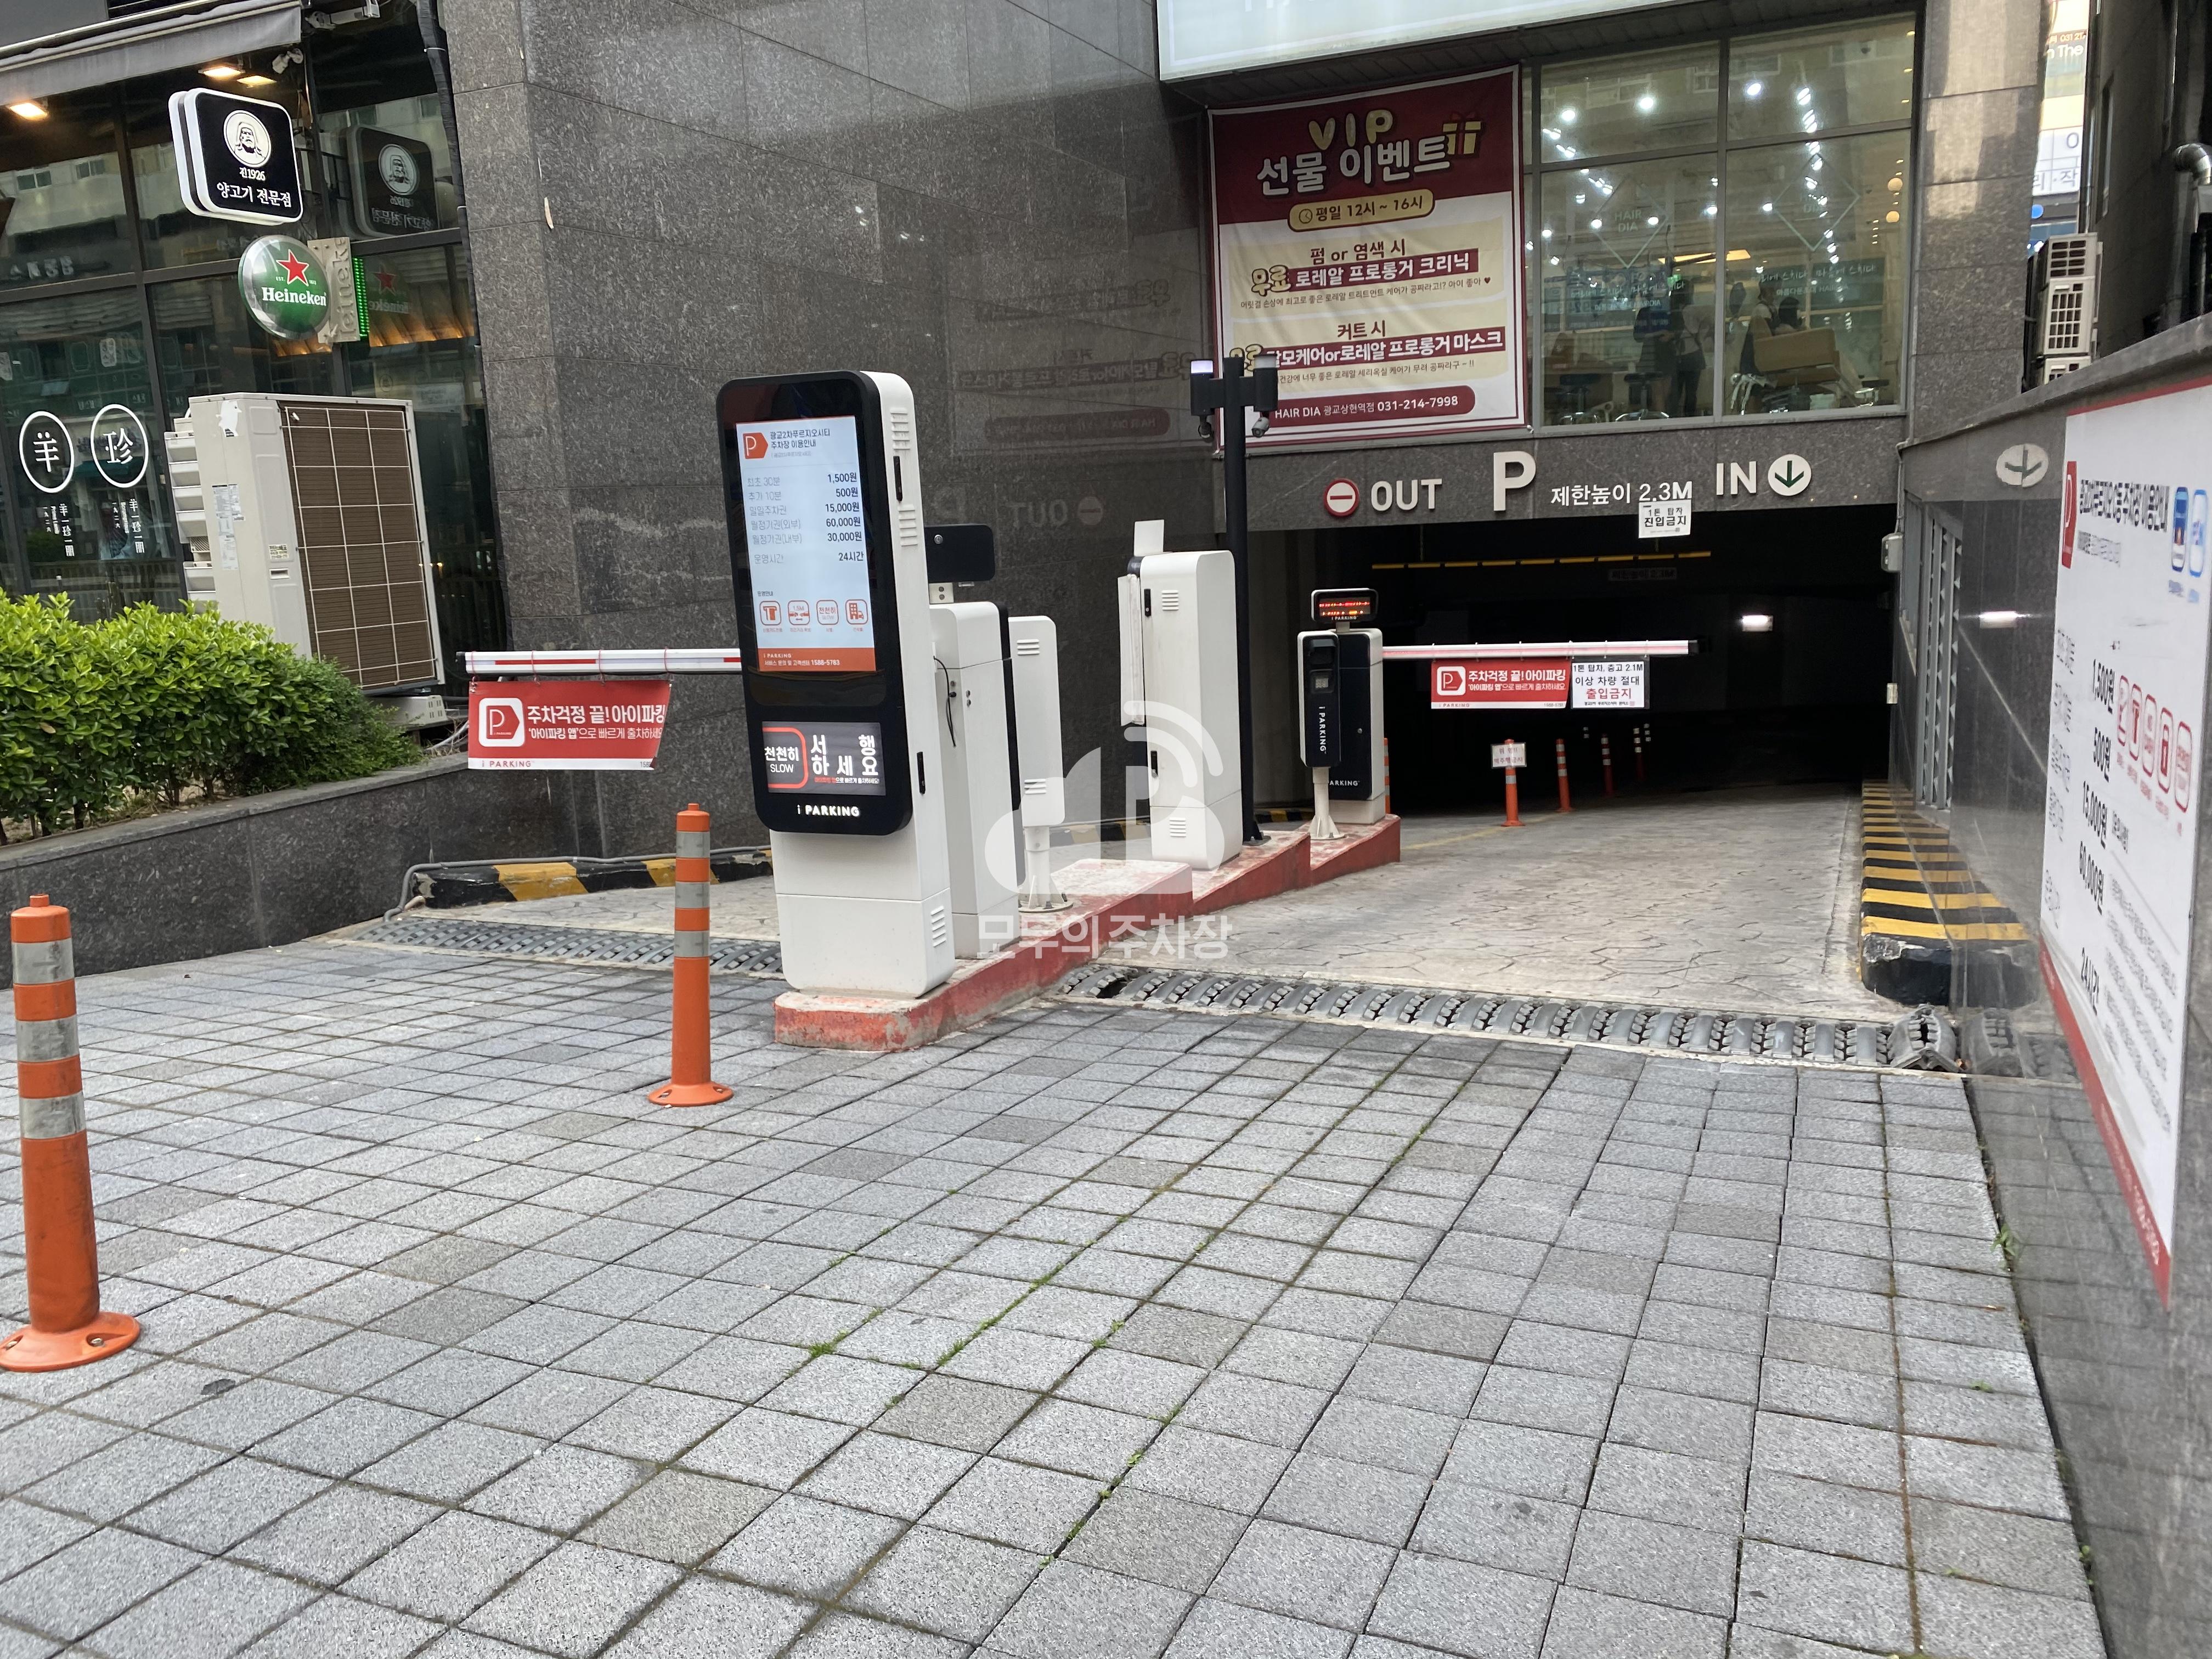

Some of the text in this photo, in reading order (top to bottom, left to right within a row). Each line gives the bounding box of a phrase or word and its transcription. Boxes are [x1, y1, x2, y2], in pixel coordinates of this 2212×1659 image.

[2057, 44, 2084, 57] The
[1308, 109, 1393, 150] VIP
[1257, 136, 1451, 196] 선물 이벤트
[217, 182, 291, 207] 양고기 전문점
[1316, 205, 1341, 222] 평일
[1347, 202, 1375, 217] 12시
[1394, 195, 1423, 212] 16시
[1615, 209, 1642, 221] HAIR
[1618, 222, 1638, 232] DIA
[1310, 238, 1406, 266] 펌 or 염색 시
[1295, 267, 1344, 287] 로레알
[1348, 259, 1414, 283] 프로롱거
[1419, 252, 1470, 275] 크리닉
[261, 287, 326, 306] Heineken
[1309, 295, 1323, 304] 좋은
[1325, 292, 1346, 301] 로레알
[1386, 286, 1408, 295] 케어가
[1448, 279, 1463, 287] 아이
[1466, 278, 1481, 287] 좋아
[1337, 320, 1386, 341] 커트 시
[1389, 335, 1450, 357] 프로롱거
[1454, 331, 1503, 352] 마스크
[1302, 373, 1316, 381] 너무
[1318, 371, 1332, 381] 좋은
[1275, 396, 1458, 419] HAIR DIA 광교상현역점 031-214-7998
[770, 428, 830, 439] 광교2차푸르지오시티
[33, 428, 133, 472] 羊 珍
[771, 439, 816, 449] 주차장 이용안내
[747, 477, 780, 487] 최초 30분
[828, 472, 857, 484] 1,500원
[1493, 450, 1536, 511] P
[1716, 461, 1757, 495] IN
[748, 492, 781, 501] 추가 10분
[836, 487, 858, 498] 500원
[1371, 478, 1443, 511] OUT
[1551, 481, 1692, 506] 제한높이 2.3M
[750, 505, 787, 516] 일일주차권
[826, 502, 860, 513] 15,000원
[752, 519, 800, 531] 월정기권(외부)
[826, 517, 861, 528] 60,000원
[1644, 516, 1686, 527] 진입금지
[753, 534, 802, 544] 월정기권(내부)
[827, 532, 862, 543] 30,000원
[754, 554, 783, 564] 운영시간
[839, 551, 864, 561] 24시간
[1468, 669, 1566, 681] 주차걱정 끝! 아이파킹
[1576, 676, 1639, 686] 이상 차량 절대
[2093, 658, 2115, 715] 1,500원
[1586, 688, 1632, 699] 출입금지
[527, 704, 666, 724] 주차걱정 끝! 아이파킹
[599, 727, 624, 739] 빠르게
[764, 746, 799, 761] 천천히
[2094, 727, 2111, 783] 500원
[770, 764, 793, 773] SLOW
[805, 805, 860, 817] PARKING
[2083, 781, 2107, 849] 15,000원
[2079, 840, 2104, 916] 60,000원
[2081, 947, 2100, 1016] 24시간
